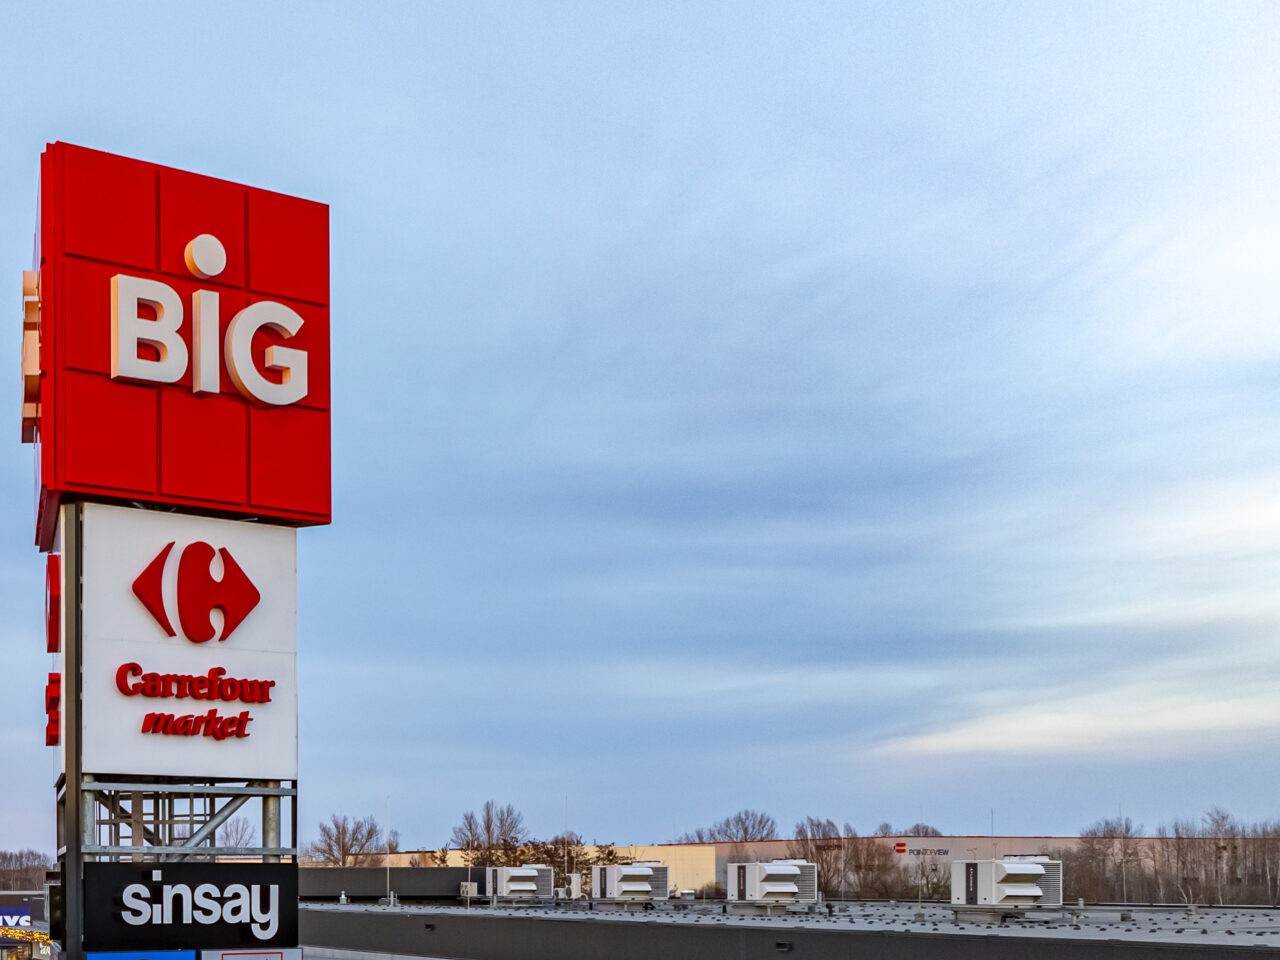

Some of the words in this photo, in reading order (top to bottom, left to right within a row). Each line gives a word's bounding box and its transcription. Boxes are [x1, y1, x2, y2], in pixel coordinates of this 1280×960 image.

[115, 662, 276, 704] Carrefour
[141, 708, 254, 741] market
[120, 869, 280, 941] sinsay
